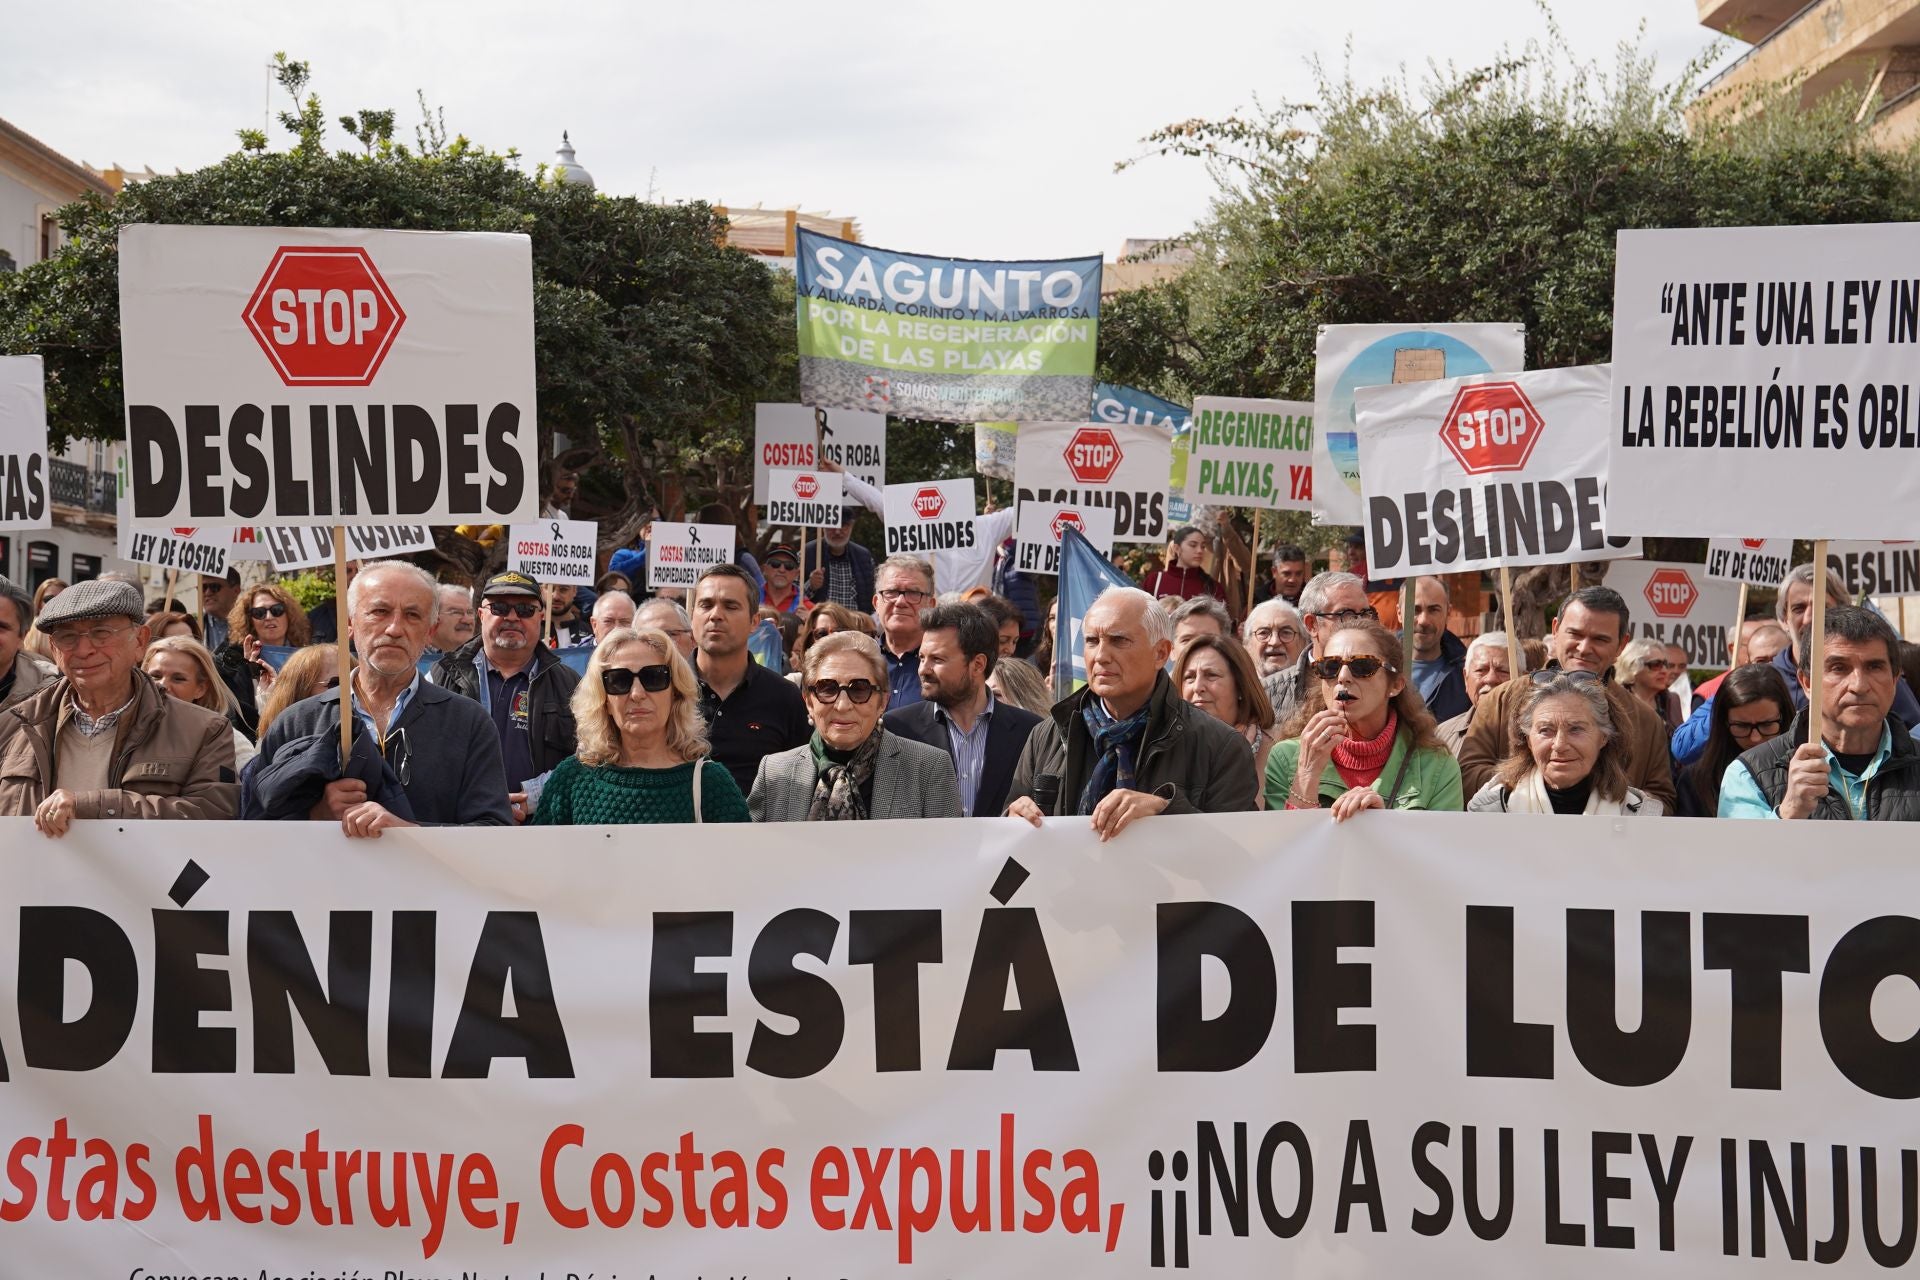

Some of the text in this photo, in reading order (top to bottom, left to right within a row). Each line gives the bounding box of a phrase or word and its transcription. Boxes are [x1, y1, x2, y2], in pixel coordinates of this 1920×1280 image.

[815, 246, 1083, 311] SAGUNTO
[272, 289, 378, 346] STOP
[809, 304, 1088, 344] POR LA REGENERACIÓN
[895, 302, 964, 321] CORINTO
[969, 308, 978, 321] Y
[984, 306, 1090, 323] MALVARROSA
[1756, 281, 1815, 346] UNA
[1824, 280, 1881, 344] LEY
[840, 335, 1043, 370] DE LAS PLAYAS
[1622, 366, 1920, 450] LA REBELIÓN ES OBL
[1192, 410, 1313, 454] ¡REGENERACI
[1457, 407, 1528, 450] STOP
[129, 402, 525, 519] DESLINDES
[763, 443, 814, 466] COSTAS
[846, 445, 881, 467] ROBA
[1073, 444, 1114, 468] STOP
[0, 453, 45, 521] AS
[795, 481, 816, 493] STOP
[1198, 460, 1279, 506] PLAYAS,
[770, 501, 840, 526] DESLINDES
[917, 496, 941, 511] STOP
[888, 520, 975, 553] DESLINDES
[1369, 477, 1632, 570] DESLINDE
[130, 533, 226, 575] LEY DE COSTAS
[517, 541, 593, 560] COSTAS NOS ROBA
[519, 560, 591, 577] NUESTRO HOGAR.
[659, 544, 727, 564] COSTAS NOS ROBA LAS
[1019, 542, 1060, 572] LEY DE
[1709, 549, 1788, 585] LEY DE COSTAS
[653, 566, 695, 584] PROPIEDADES
[1652, 583, 1690, 605] STOP
[1673, 623, 1731, 666] COSTA
[17, 855, 1920, 1100] DÉNIA ESTÁ DE LUTO
[175, 1114, 519, 1260] destruye,
[540, 1123, 786, 1231] Costas
[810, 1112, 1125, 1264] expulsa,
[1148, 1120, 1314, 1269] ¡¡NO
[1334, 1119, 1388, 1234] A
[1411, 1120, 1515, 1241] SU
[1544, 1128, 1694, 1252] LEY
